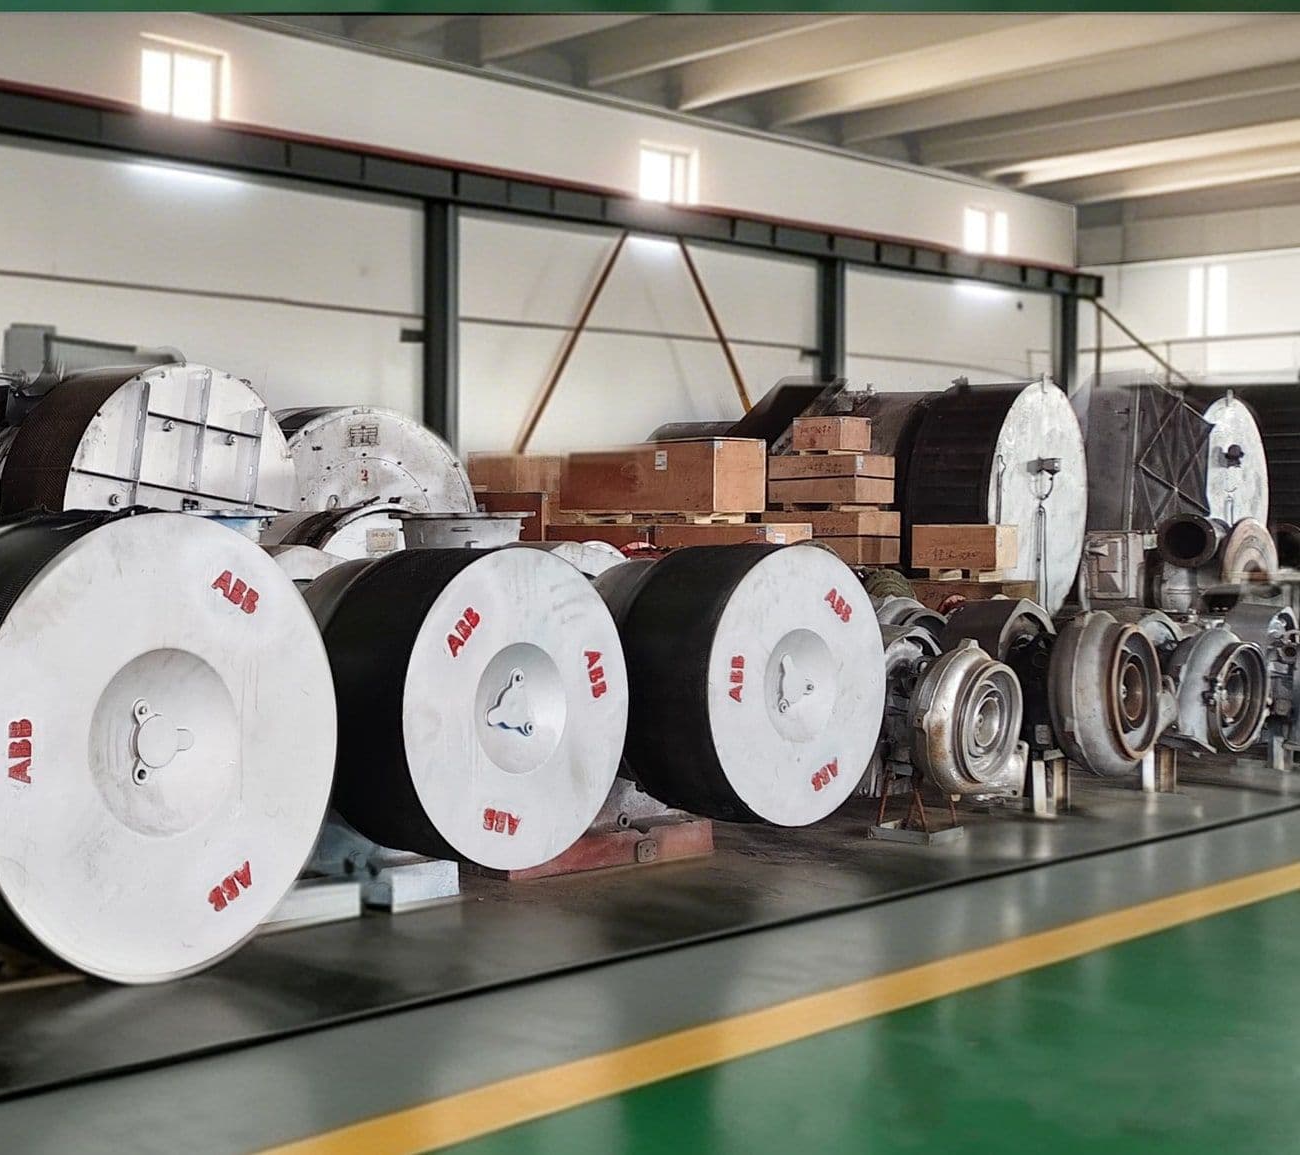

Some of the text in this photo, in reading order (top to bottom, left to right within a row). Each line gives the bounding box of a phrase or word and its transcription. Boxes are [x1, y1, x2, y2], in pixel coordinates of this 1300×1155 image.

[211, 569, 259, 615] ABB
[823, 587, 854, 623] ABB
[446, 606, 482, 657] ABB
[583, 650, 608, 700] ABB
[729, 655, 745, 703] ABB
[8, 718, 33, 784] ABB
[811, 758, 840, 792] ABB
[482, 807, 521, 836] ABB
[207, 860, 253, 912] ABB
